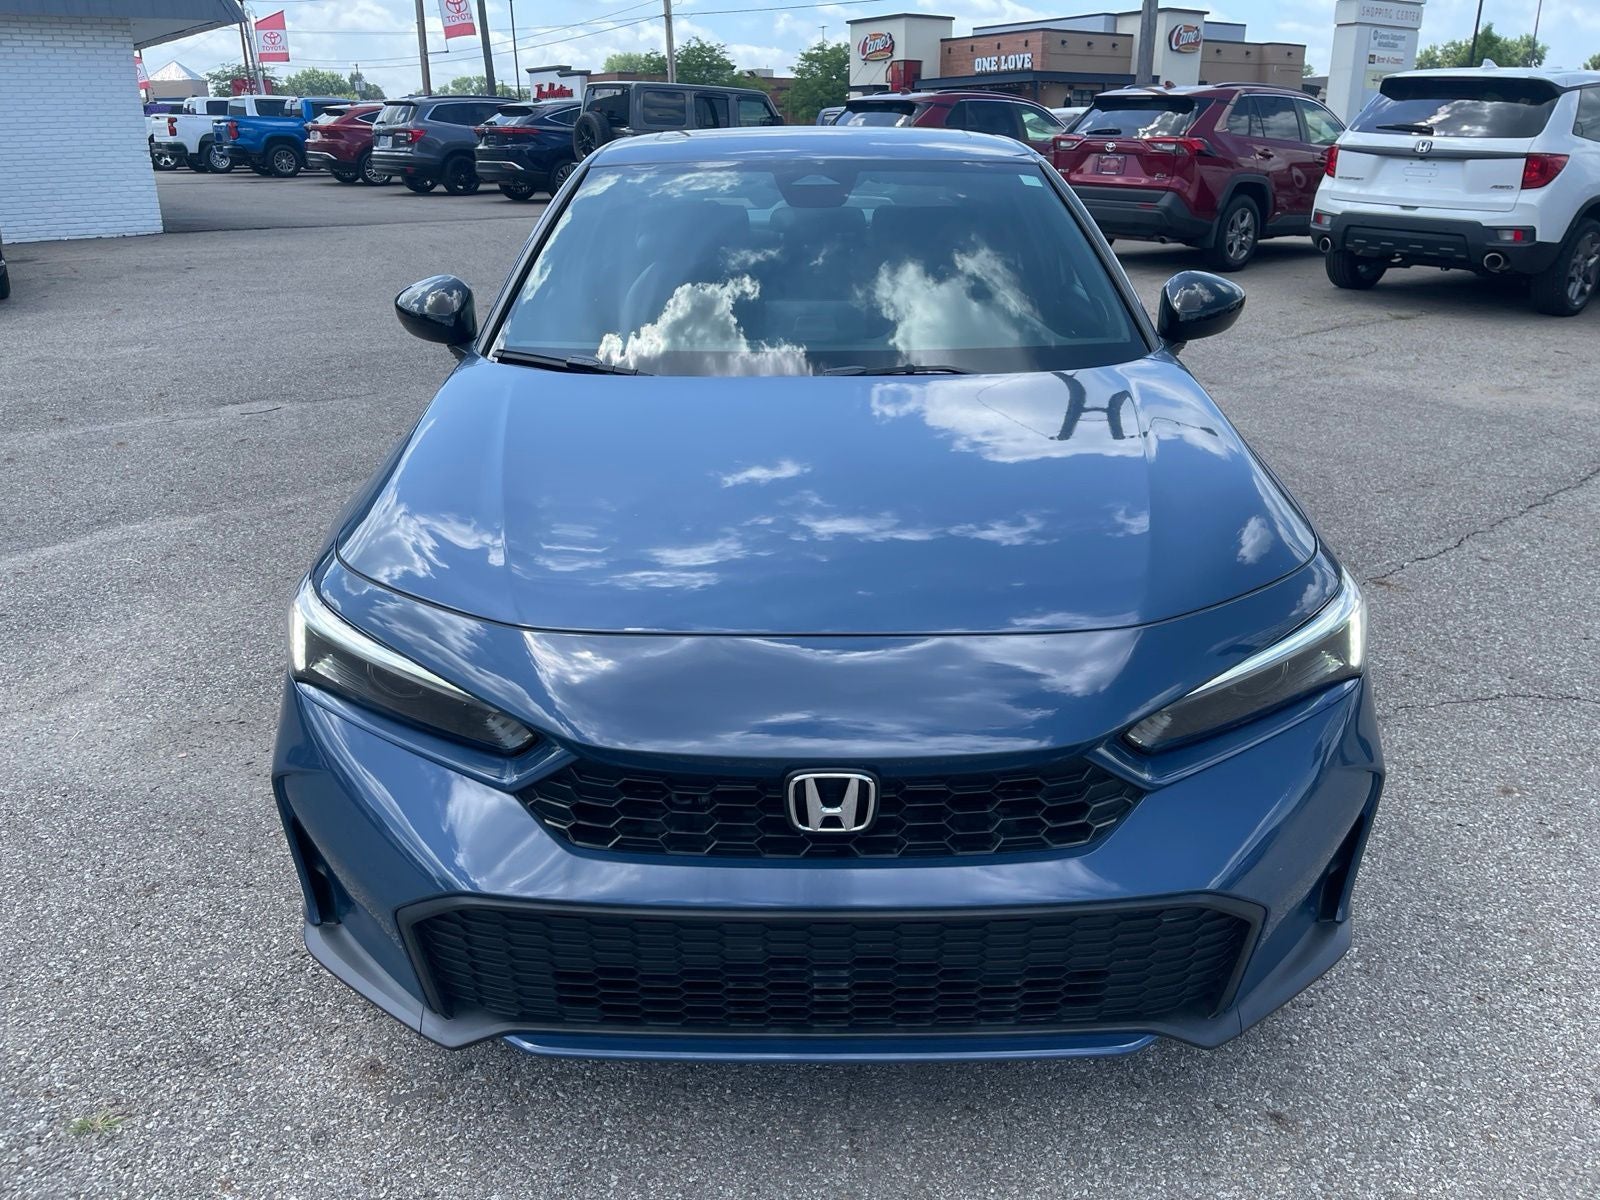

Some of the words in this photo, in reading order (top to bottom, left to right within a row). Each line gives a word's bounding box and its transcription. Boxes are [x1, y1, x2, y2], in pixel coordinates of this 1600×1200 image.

[446, 12, 473, 23] TOYOTA
[1361, 6, 1393, 19] SHOPPING
[1396, 9, 1420, 22] CENTER
[974, 56, 999, 72] ONE
[1000, 52, 1033, 70] LOVE
